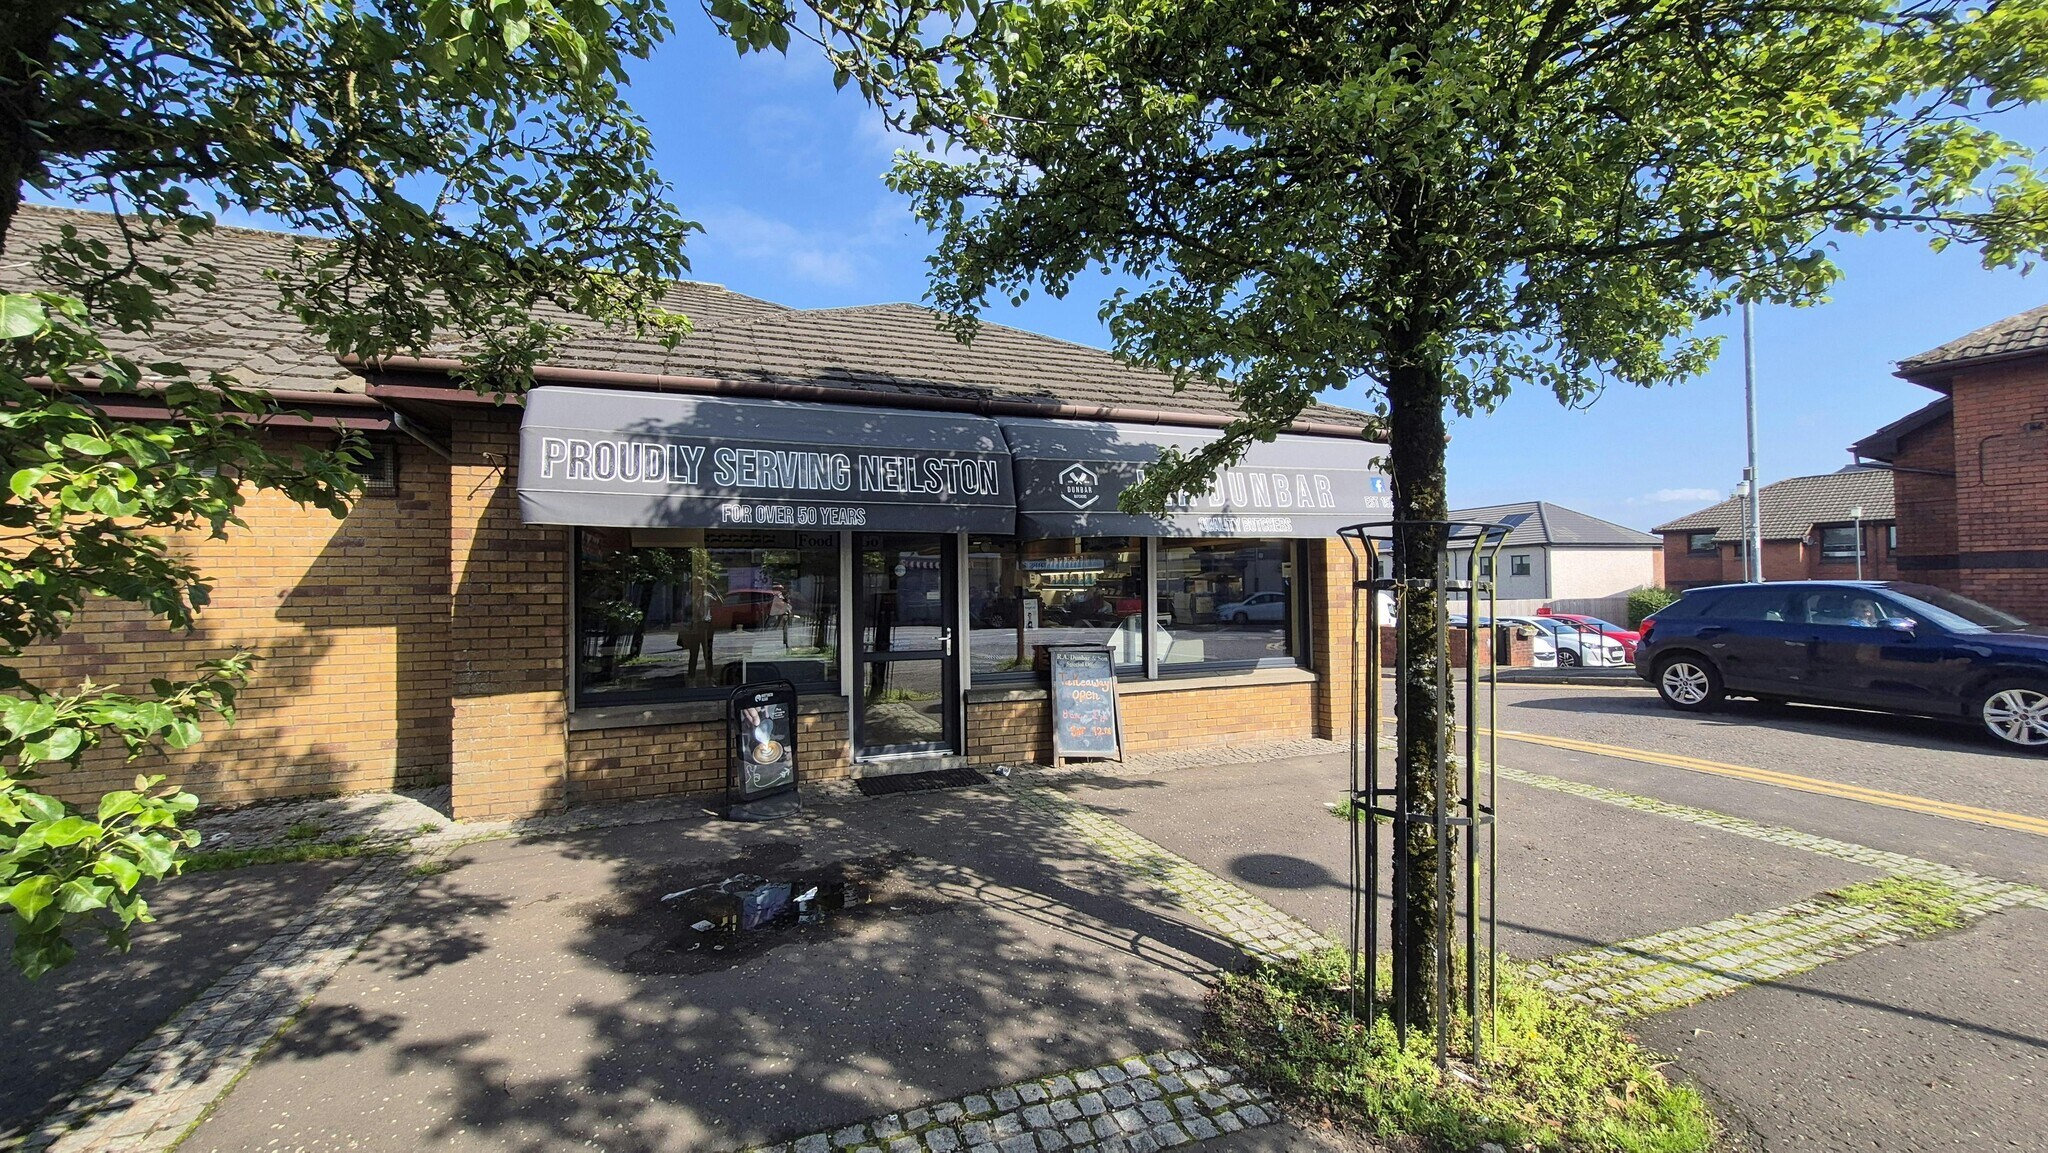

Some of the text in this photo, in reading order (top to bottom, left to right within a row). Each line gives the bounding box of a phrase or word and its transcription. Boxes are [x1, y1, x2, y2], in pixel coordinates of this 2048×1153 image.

[541, 436, 999, 496] PROUDLY SERVING NEILSTON
[1066, 485, 1092, 494] DUNBAR
[1209, 472, 1335, 508] DUNBAR
[722, 503, 866, 527] FOR OVER 50 YEARS
[1198, 516, 1293, 532] QUALITY BUTCHERS
[799, 534, 833, 546] Food
